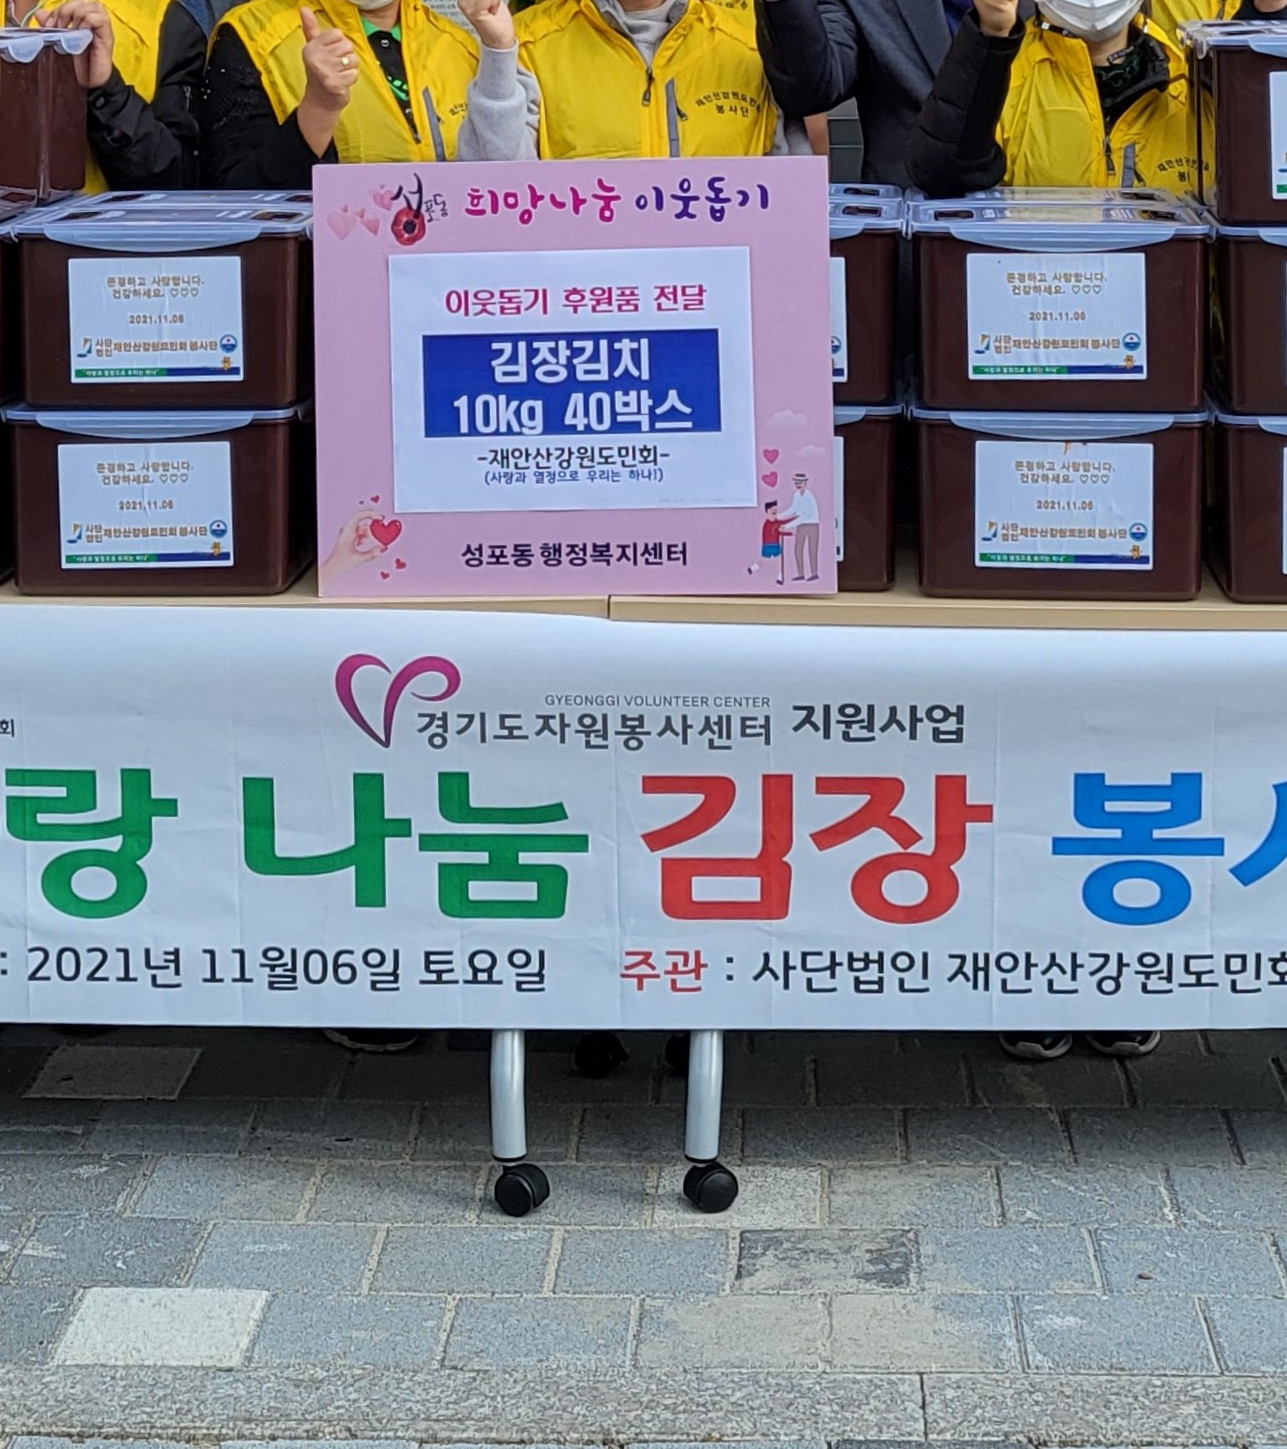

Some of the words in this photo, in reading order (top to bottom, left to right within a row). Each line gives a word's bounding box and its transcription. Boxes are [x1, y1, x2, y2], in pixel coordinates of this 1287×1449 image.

[464, 178, 622, 225] 희망나눔
[634, 176, 770, 223] 이웃돕기
[445, 287, 549, 317] 이웃돕기
[562, 286, 641, 315] 후원품
[653, 284, 707, 313] 전달
[490, 337, 651, 385] 김장김치
[453, 394, 544, 435] 10kg
[564, 391, 693, 432] 40박스
[477, 445, 670, 471] -재안산강원도민회-
[484, 470, 527, 486] (사랑과
[533, 470, 580, 485] 열정으로
[586, 469, 622, 483] 우리는
[461, 542, 535, 568] 성포동
[540, 540, 688, 567] 행정복지센터
[544, 694, 621, 708] GYEONGGI
[624, 694, 709, 708] VOLUNTEER
[713, 695, 771, 709] CENTER
[416, 710, 772, 751] 경기도자원봉사센터
[791, 702, 966, 745] 지원사업
[242, 769, 590, 920] 나눔
[640, 772, 995, 926] 김장
[26, 945, 183, 990] 2021년
[200, 945, 401, 993] 11월06일
[418, 946, 547, 994] 토요일
[618, 949, 708, 994] 주관
[750, 948, 931, 995] 사단법인
